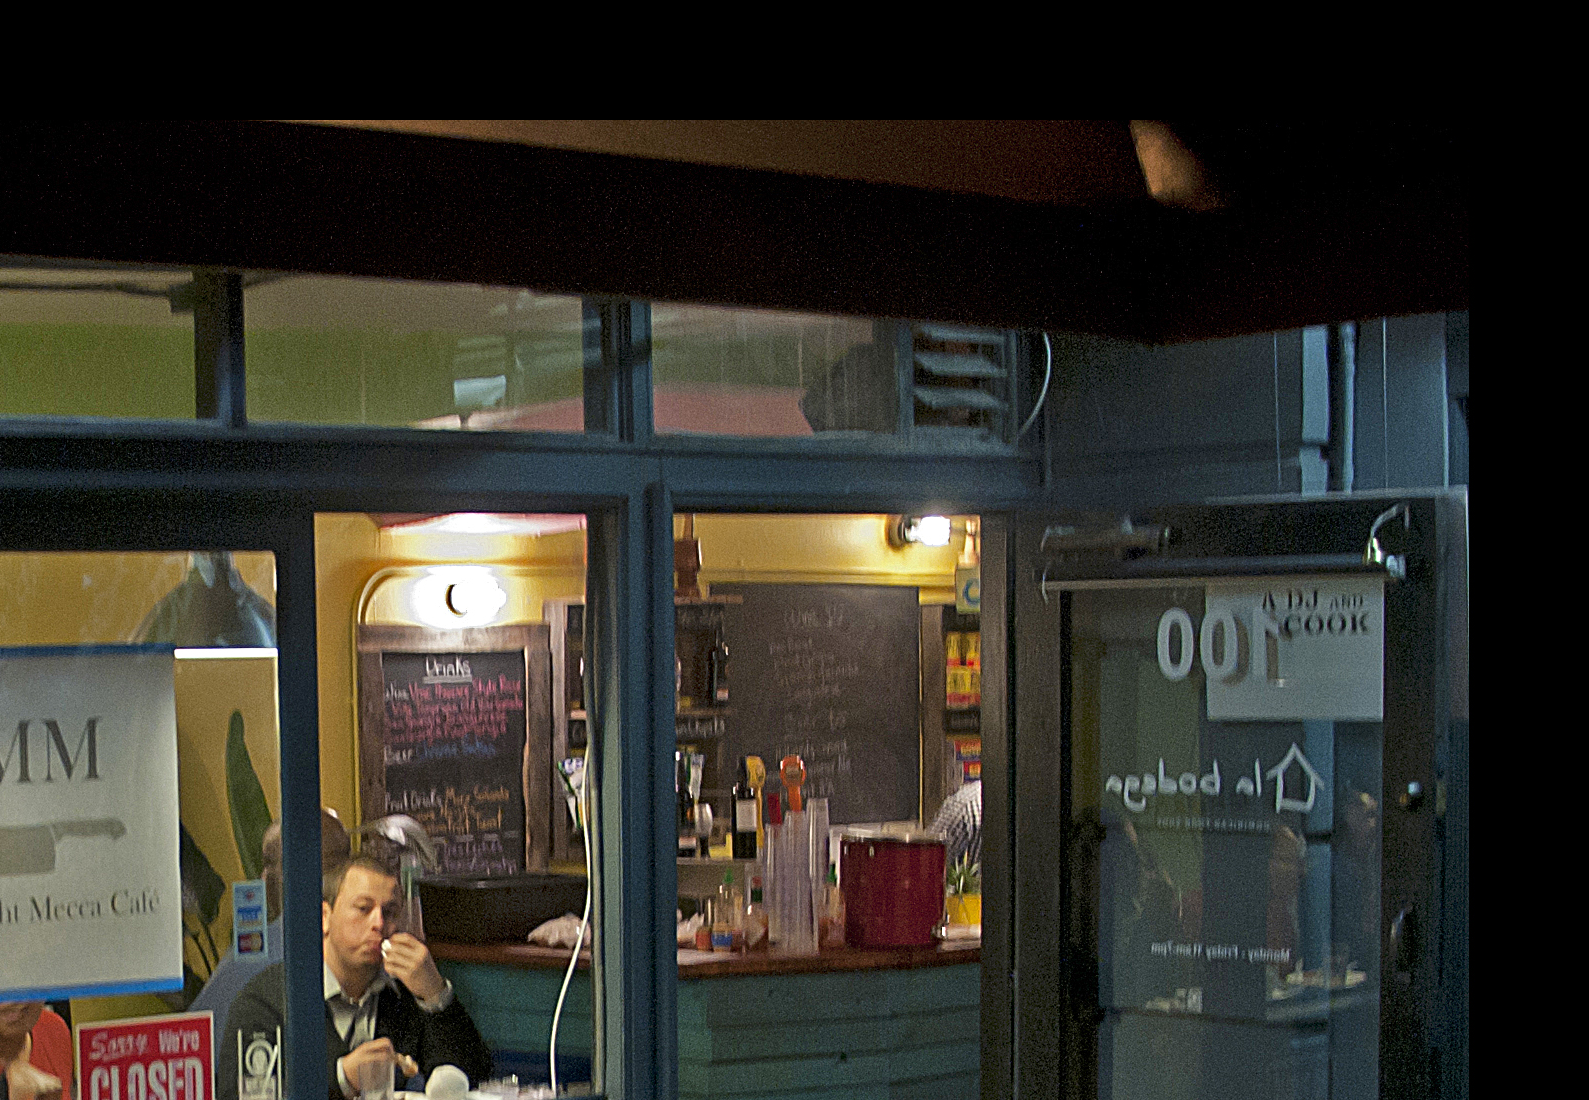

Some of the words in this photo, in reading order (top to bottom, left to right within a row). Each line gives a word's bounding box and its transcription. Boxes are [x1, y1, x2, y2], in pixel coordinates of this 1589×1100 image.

[1263, 591, 1276, 611] A
[1287, 589, 1318, 611] DJ
[1330, 593, 1364, 611] AND
[1284, 612, 1368, 635] COOK
[425, 656, 472, 677] Drinks
[29, 894, 103, 924] Mecca
[111, 886, 161, 916] Café
[89, 1031, 149, 1061] Sorry
[158, 1029, 200, 1055] We're
